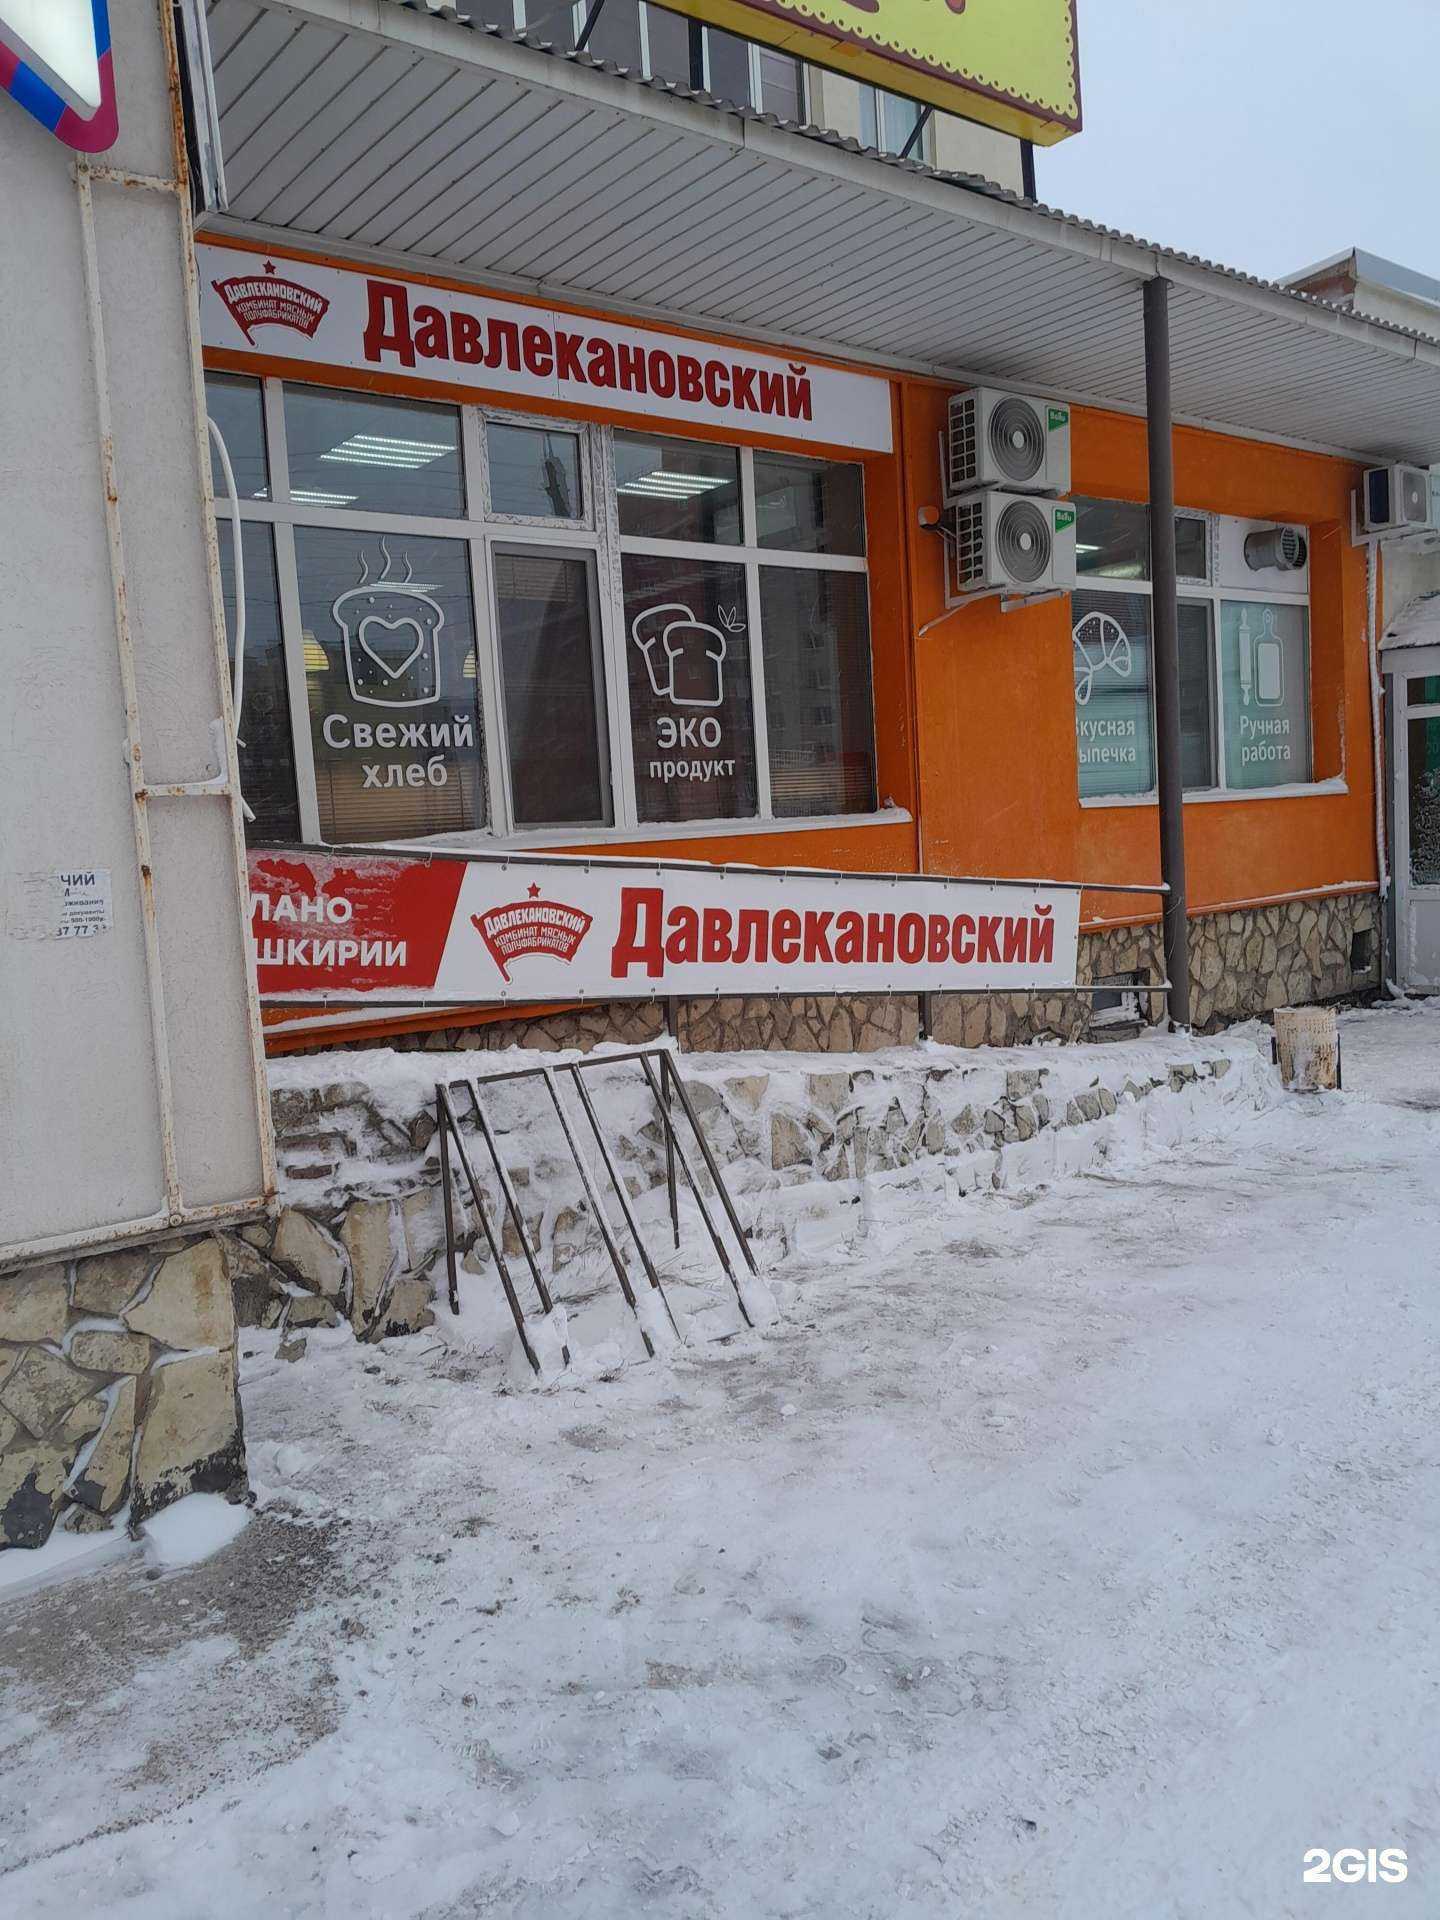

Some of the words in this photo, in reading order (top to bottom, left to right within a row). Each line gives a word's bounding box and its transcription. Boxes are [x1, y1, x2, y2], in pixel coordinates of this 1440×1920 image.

[224, 281, 323, 314] ДАВЛЕКАНОВСКИЙ
[236, 299, 278, 313] КОМБИНАТ
[363, 279, 813, 421] Давлекановский
[322, 713, 474, 749] Свежий
[656, 716, 722, 749] ЭКО
[1240, 715, 1290, 740] Ручная
[1241, 740, 1291, 767] работа
[362, 754, 448, 788] хлеб
[649, 759, 736, 783] продукт
[250, 893, 353, 924] ЛАНО
[483, 907, 586, 939] ДАВЛЕКАНОВСКИЙ
[494, 926, 538, 948] КОМБИНАТ
[540, 926, 576, 945] МЯСНЫХ
[610, 886, 1054, 979] Давлекановский
